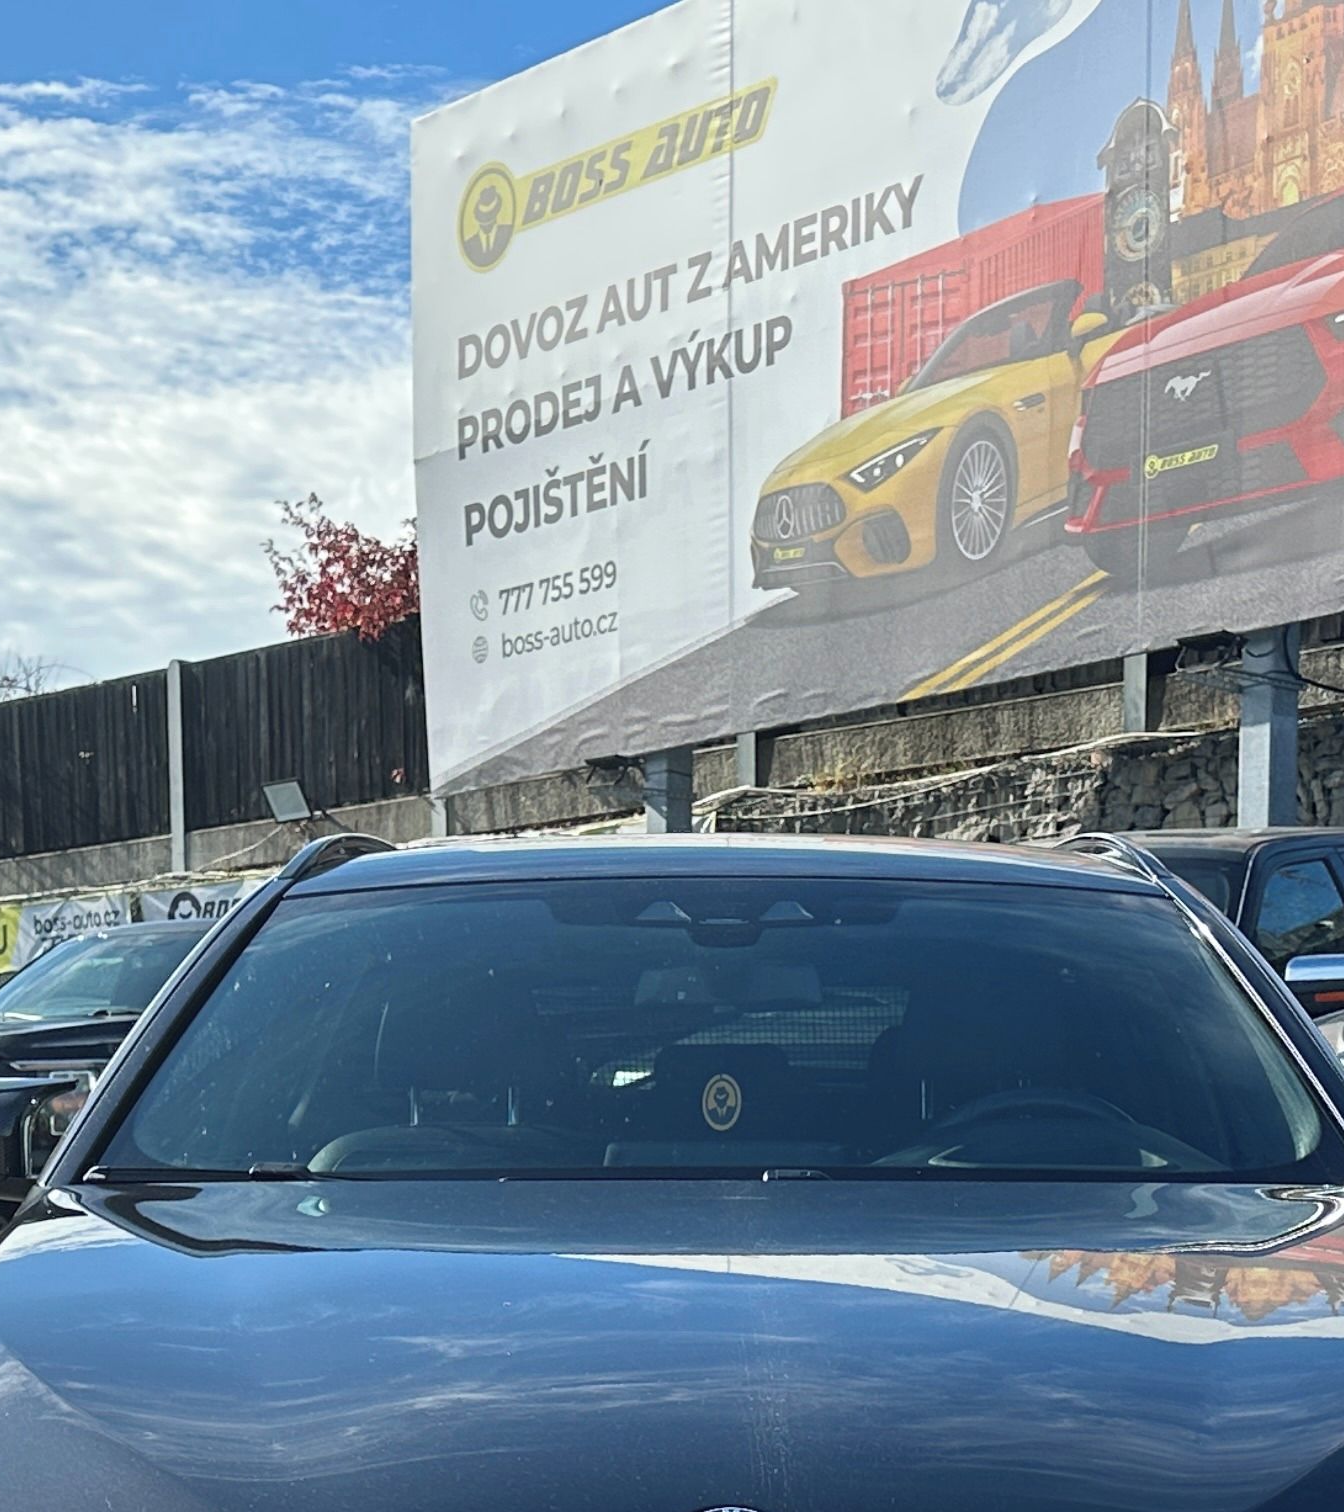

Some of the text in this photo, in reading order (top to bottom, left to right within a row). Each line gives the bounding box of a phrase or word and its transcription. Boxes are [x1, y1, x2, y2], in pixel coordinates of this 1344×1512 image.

[522, 85, 771, 226] BOSS AUTO
[457, 173, 925, 381] DOVOZ AUT Z AMERIKY
[458, 315, 793, 461] PRODEJ A VÝKUP
[464, 438, 651, 547] POJIŠTĚNÍ
[499, 560, 618, 616] 777 755 599
[501, 611, 619, 659] boss-auto.cz
